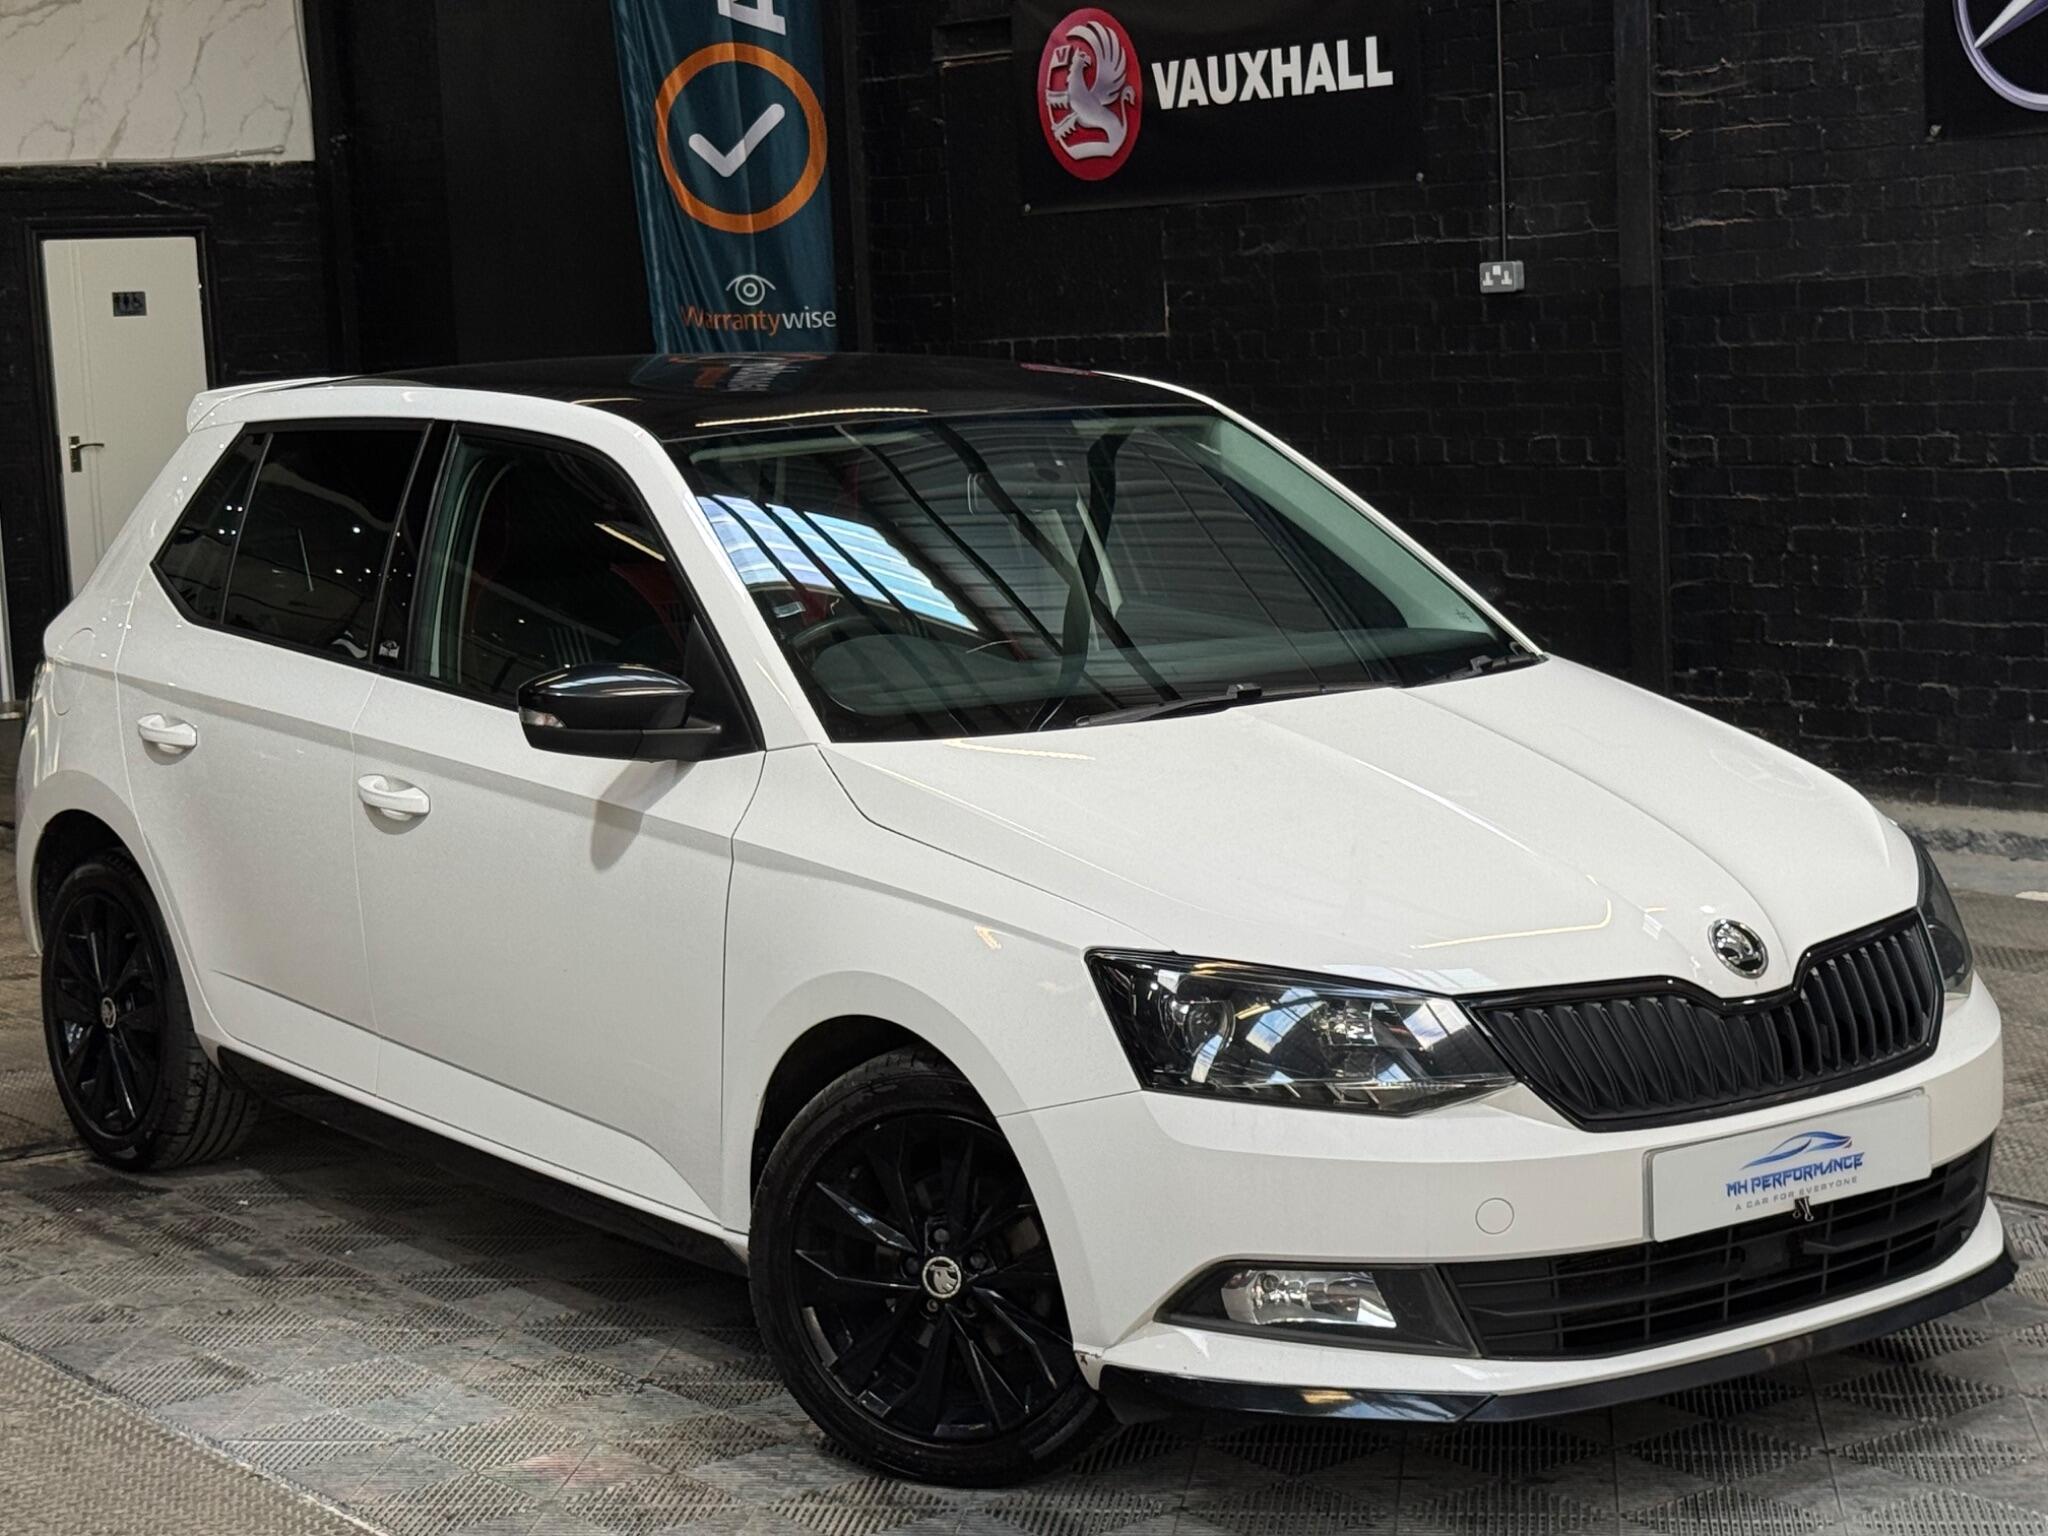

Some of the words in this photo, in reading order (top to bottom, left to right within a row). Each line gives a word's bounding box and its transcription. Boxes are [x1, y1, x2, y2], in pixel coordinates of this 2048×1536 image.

[1151, 35, 1394, 110] VAUXHALL
[680, 305, 837, 336] Warrantywise
[1726, 1181, 1748, 1197] MH
[1750, 1152, 1865, 1194] PERFORMANCE
[1735, 1203, 1742, 1211] A
[1746, 1197, 1769, 1209] CAR
[1773, 1191, 1795, 1203] FOR
[1799, 1175, 1858, 1196] EVERYONE
